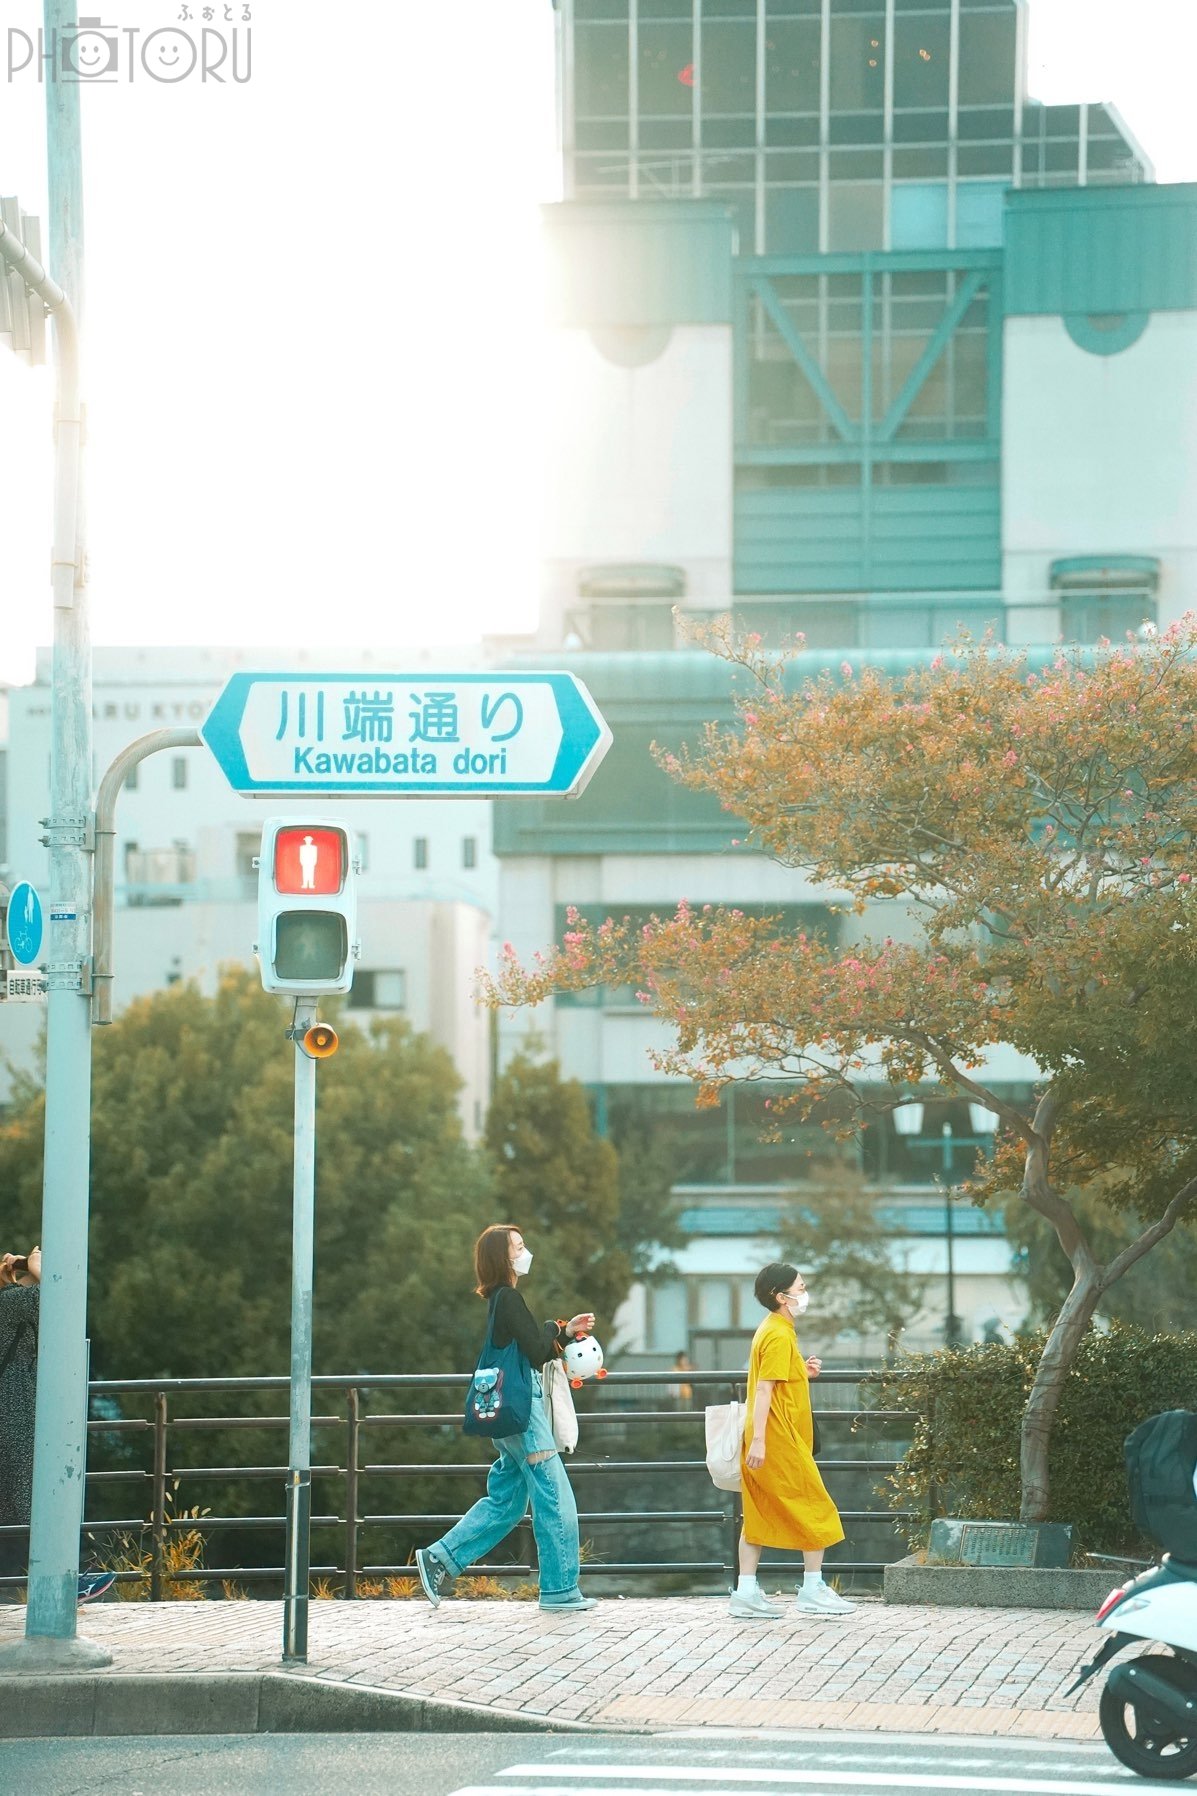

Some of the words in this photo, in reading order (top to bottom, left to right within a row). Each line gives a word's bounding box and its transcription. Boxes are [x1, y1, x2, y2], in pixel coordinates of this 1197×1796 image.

[275, 689, 524, 744] 川端通り
[294, 747, 437, 775] Kawabata
[452, 747, 507, 775] dori
